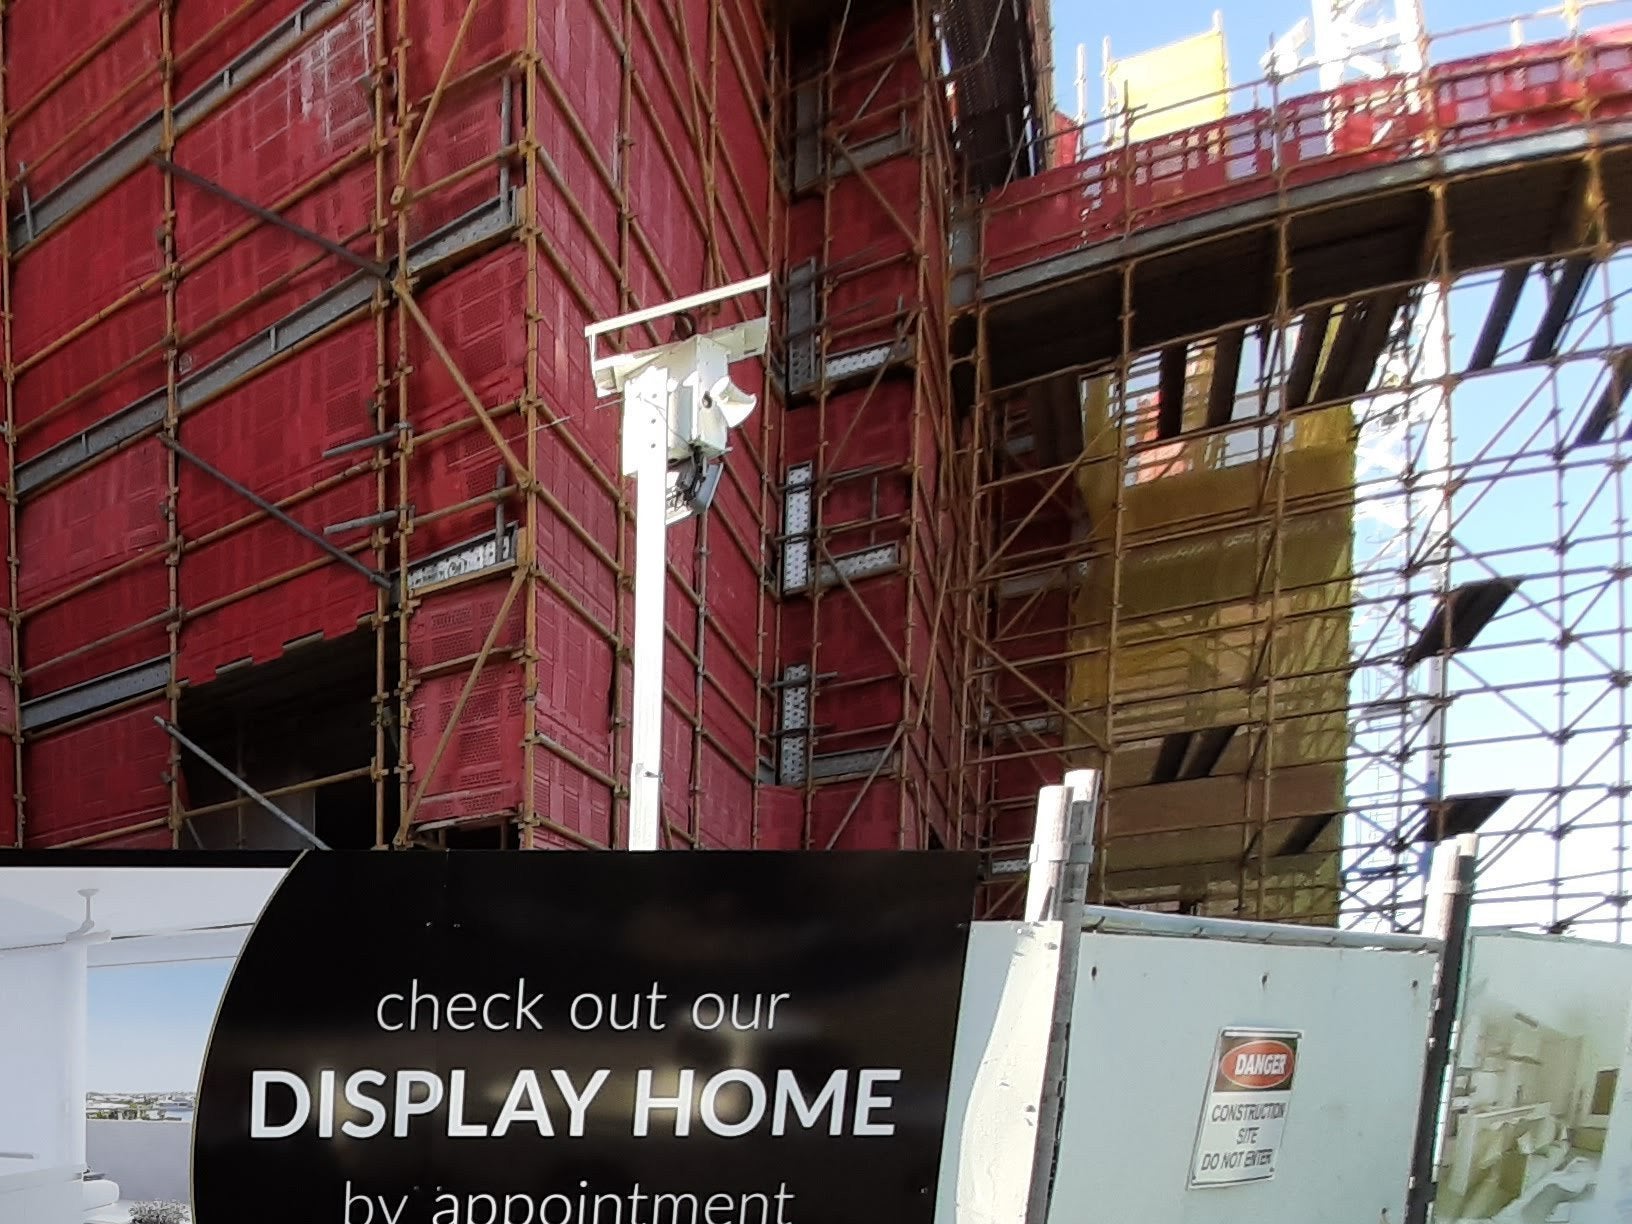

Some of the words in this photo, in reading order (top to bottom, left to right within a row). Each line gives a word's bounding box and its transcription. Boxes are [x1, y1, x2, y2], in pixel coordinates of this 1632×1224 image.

[376, 978, 544, 1031] check
[569, 981, 667, 1031] out
[691, 991, 790, 1031] our
[1234, 1053, 1288, 1076] DANGER
[250, 1068, 611, 1139] DISPLAY
[632, 1067, 902, 1138] HOME
[1211, 1102, 1287, 1122] CONSTRUCTION
[1236, 1126, 1260, 1145] SITE
[1201, 1152, 1220, 1171] DO
[1221, 1151, 1244, 1169] NOT
[1244, 1148, 1273, 1168] ENTER
